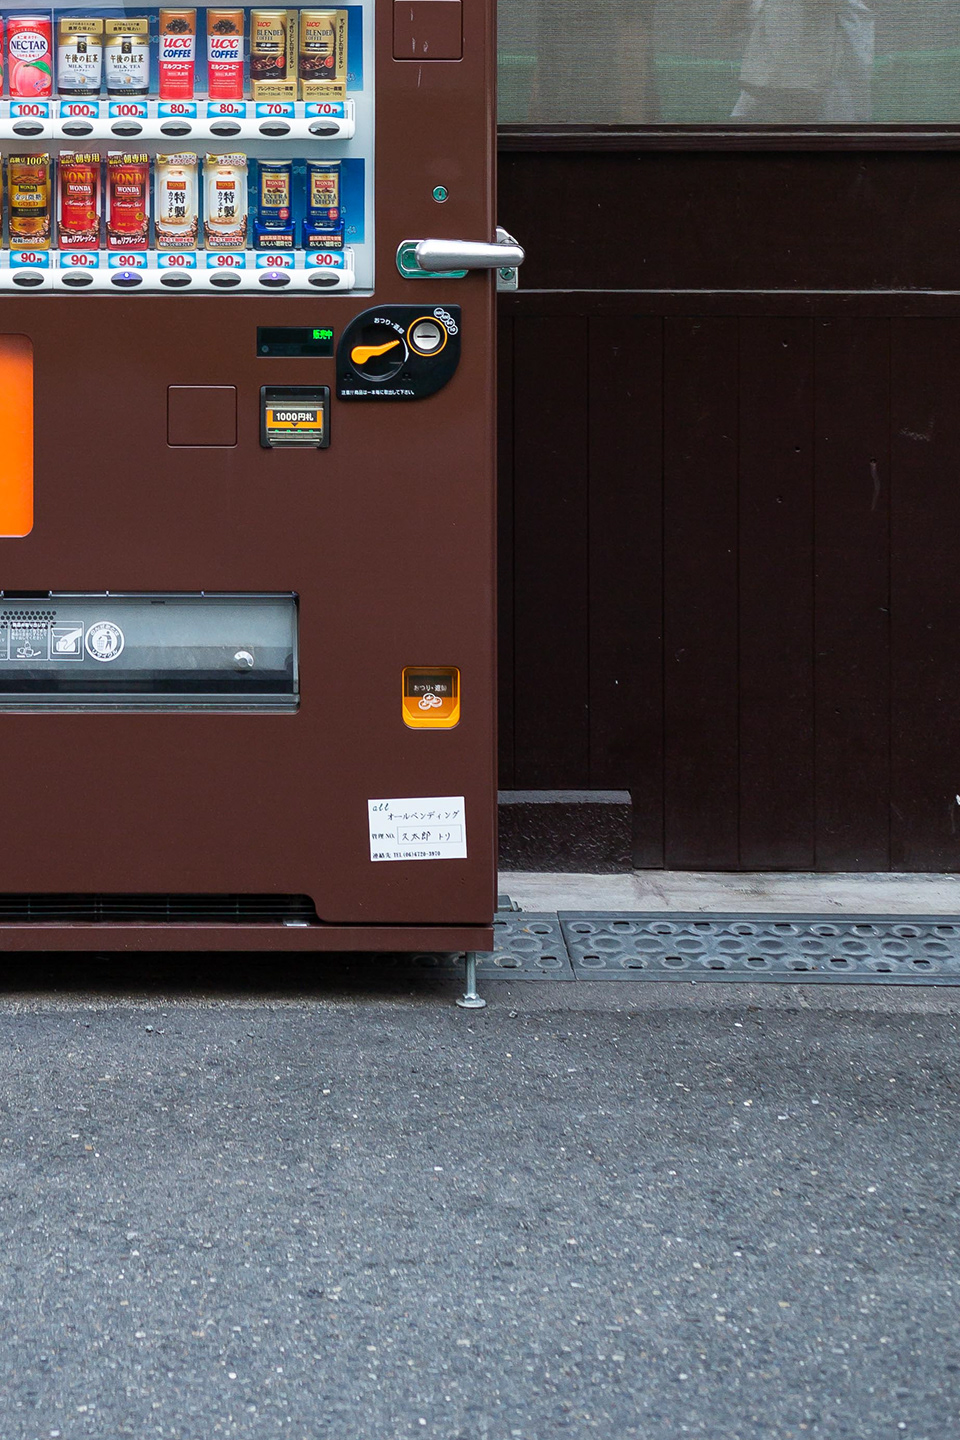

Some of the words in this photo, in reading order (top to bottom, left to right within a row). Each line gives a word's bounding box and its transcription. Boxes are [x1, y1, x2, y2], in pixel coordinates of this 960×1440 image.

[10, 40, 46, 50] NECTAR
[164, 38, 192, 48] UCC
[211, 38, 238, 48] UCC
[65, 54, 98, 63] 午後の紅茶
[163, 49, 192, 58] COFFEE
[210, 50, 238, 58] COFFEE
[110, 54, 144, 64] 午後の紅茶
[76, 153, 100, 163] 朝専用
[124, 153, 148, 164] 朝専用
[174, 192, 185, 218] 特製
[224, 191, 235, 217] 特製
[313, 329, 333, 340] 販売中
[276, 412, 314, 422] 1000円札
[372, 803, 390, 812] all
[388, 810, 460, 820] オールベンディング
